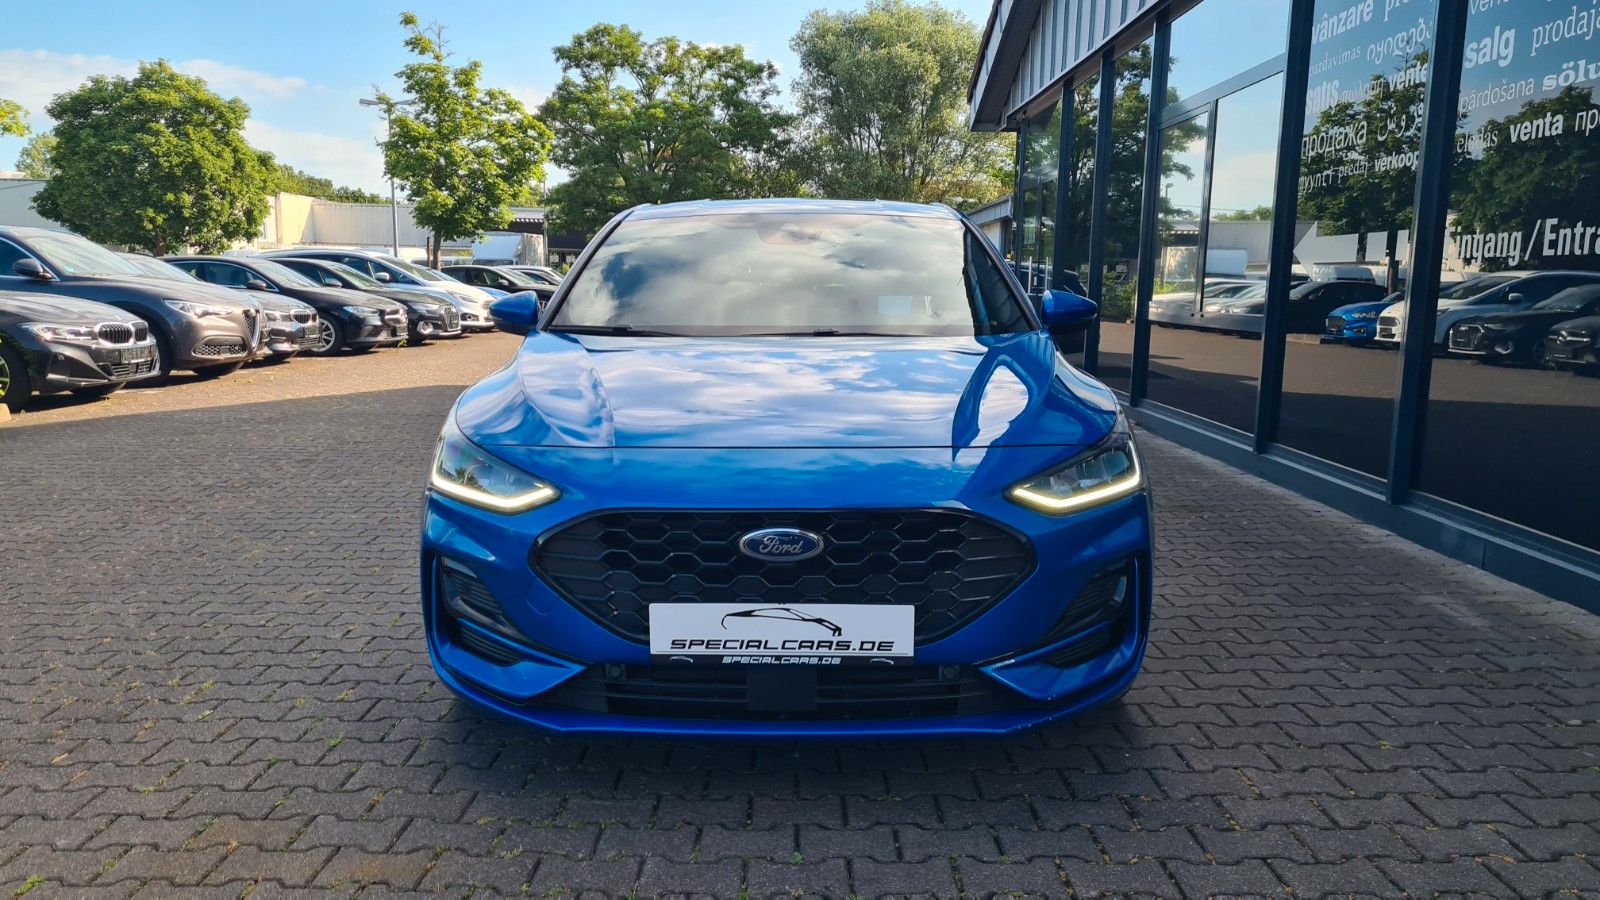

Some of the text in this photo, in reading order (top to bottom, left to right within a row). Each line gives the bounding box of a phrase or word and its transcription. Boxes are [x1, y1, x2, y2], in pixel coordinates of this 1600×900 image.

[1311, 0, 1374, 45] vânzare
[1464, 25, 1516, 68] salg
[1301, 120, 1367, 161] продажа
[1510, 111, 1564, 143] venta
[759, 534, 804, 555] Ford
[669, 638, 895, 652] SPECIALCARS.DE
